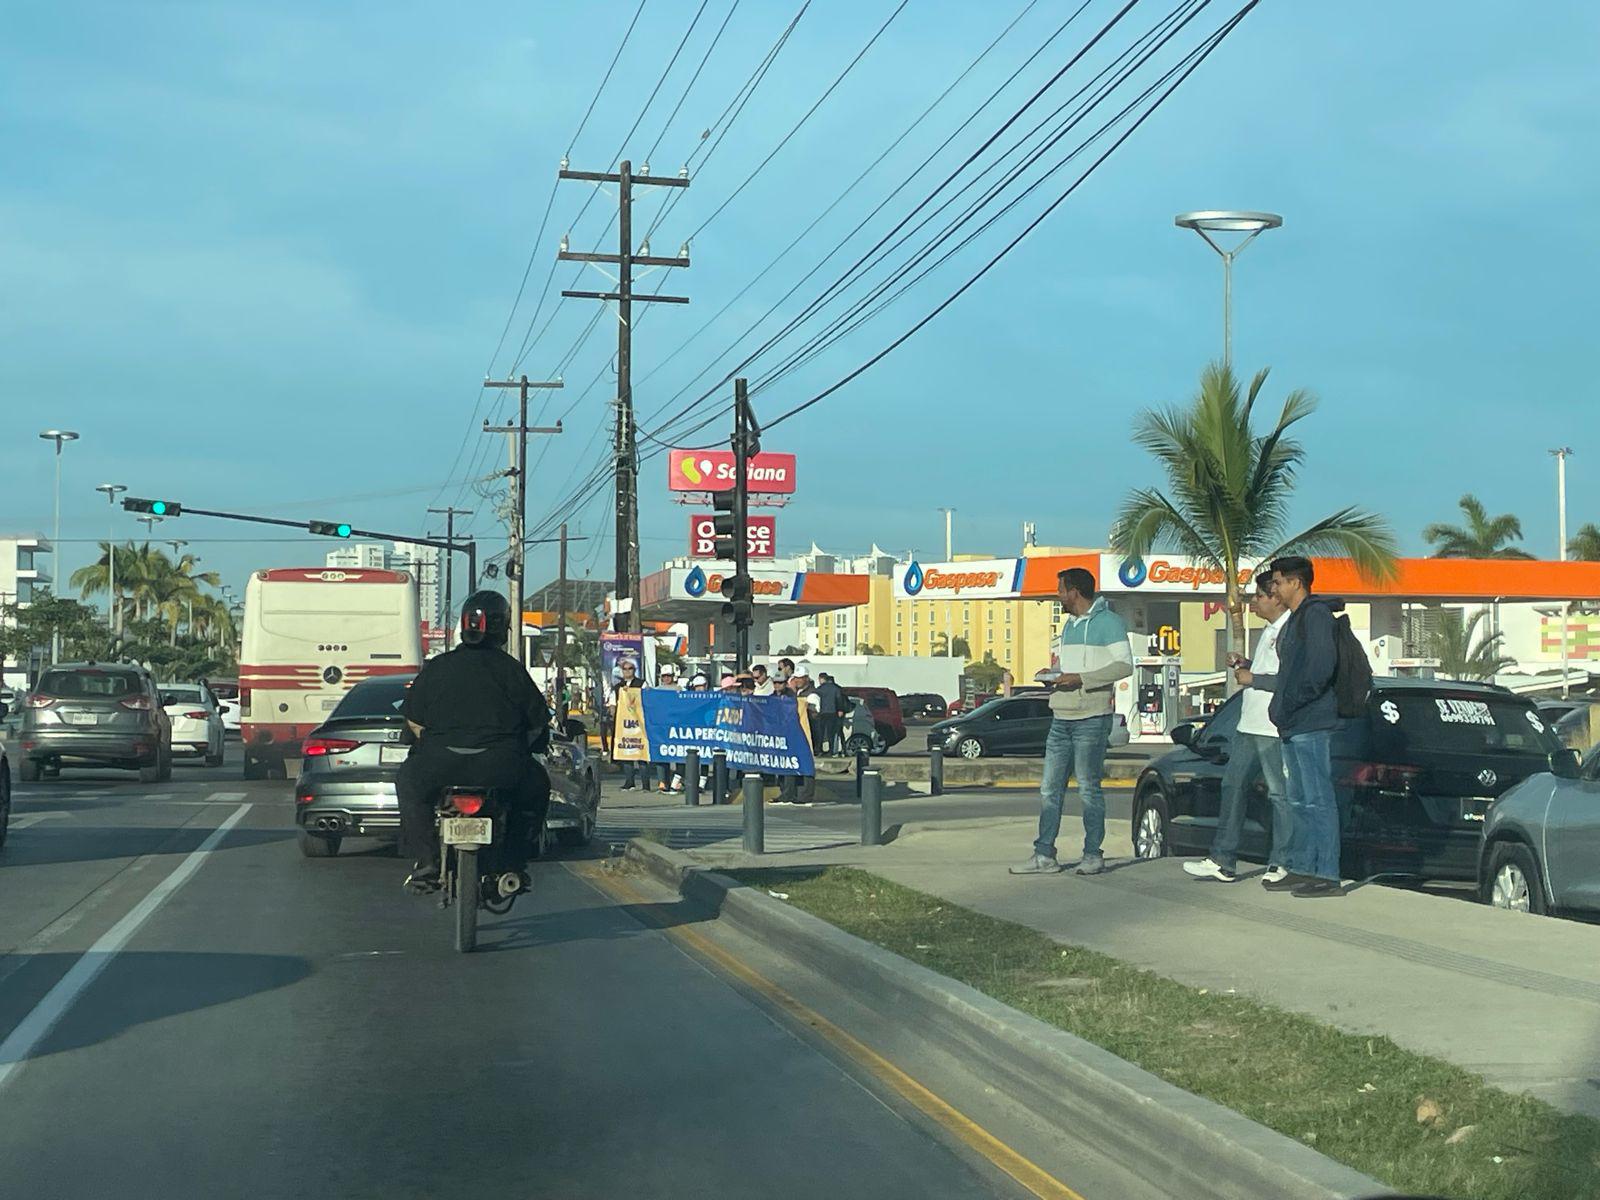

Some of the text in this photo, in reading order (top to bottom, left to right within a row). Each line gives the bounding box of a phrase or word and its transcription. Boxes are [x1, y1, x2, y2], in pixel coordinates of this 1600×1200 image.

[716, 462, 786, 482] Soiana
[697, 520, 770, 539] Oce
[697, 539, 770, 554] DOT
[708, 573, 783, 596] Gasa
[924, 568, 998, 595] Gaspasa
[1148, 560, 1253, 590] Gaspaa
[668, 726, 679, 739] A
[679, 727, 694, 740] LA
